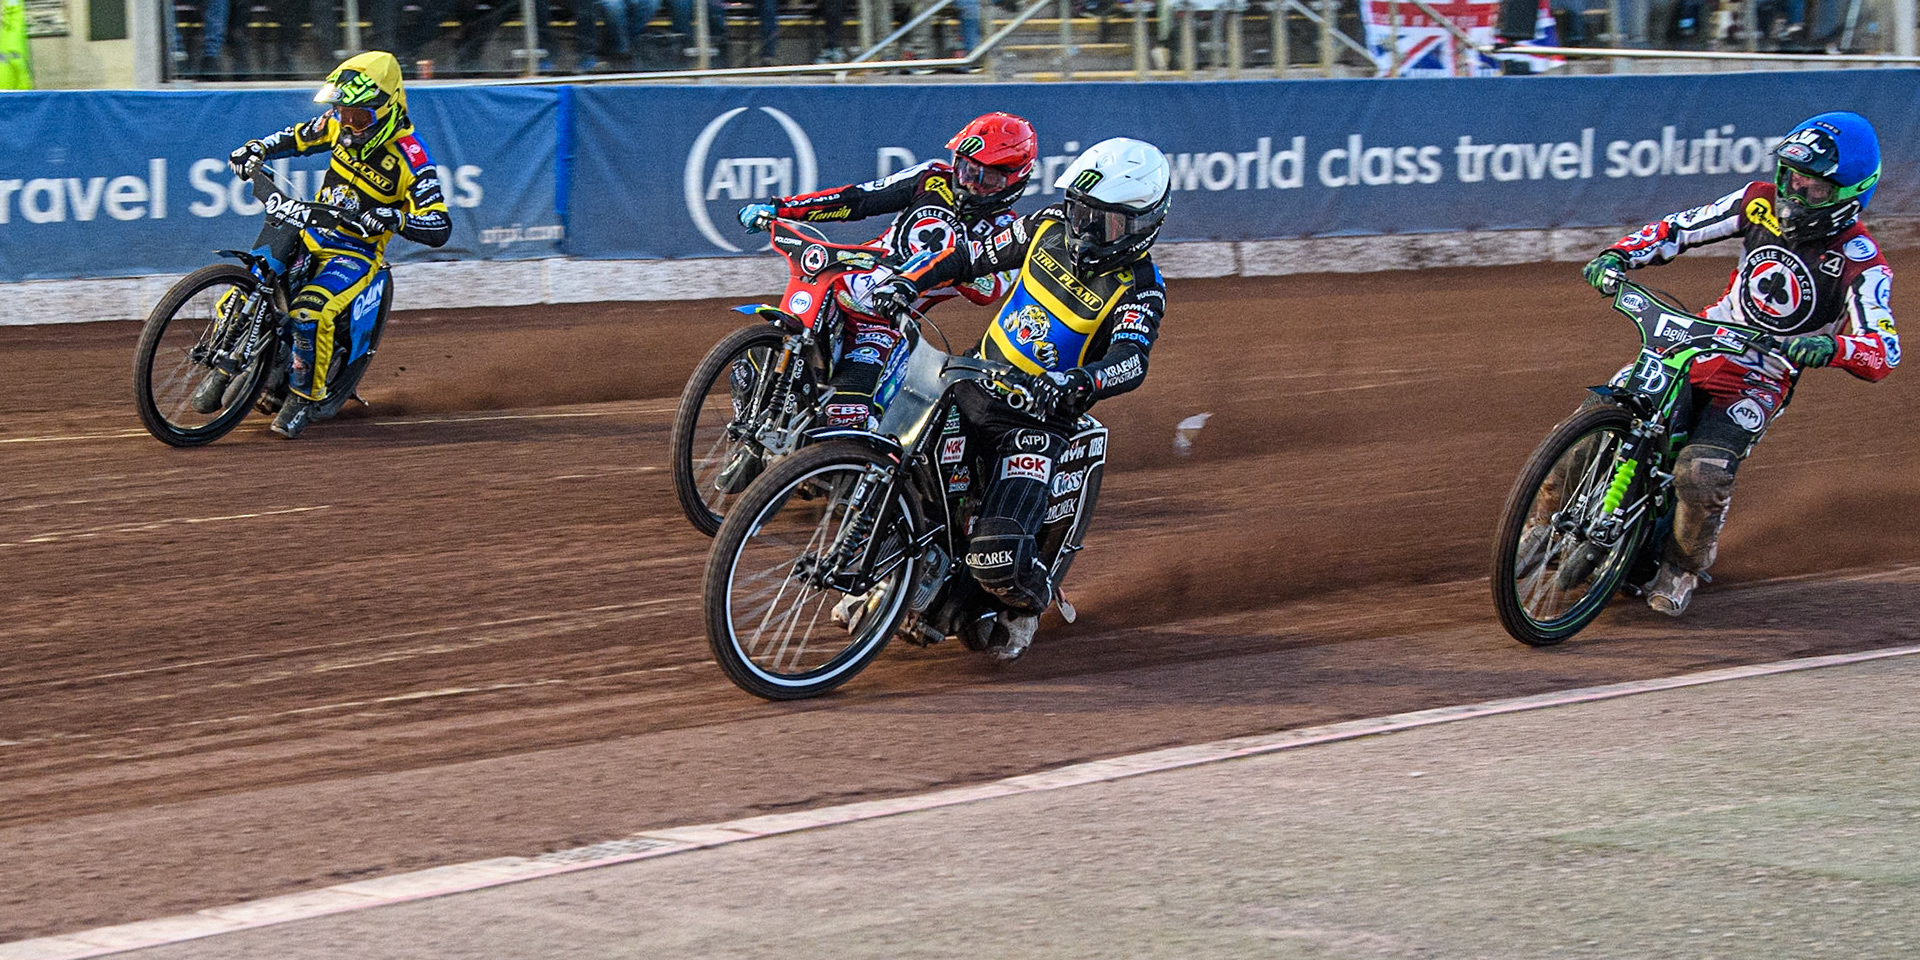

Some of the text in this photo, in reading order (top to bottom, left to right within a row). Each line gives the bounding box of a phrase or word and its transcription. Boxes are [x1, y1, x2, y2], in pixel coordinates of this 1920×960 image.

[381, 154, 397, 171] 6
[1318, 133, 1443, 188] class
[1454, 127, 1595, 183] travel
[706, 157, 793, 200] ATPI
[0, 157, 168, 224] ravel
[916, 208, 944, 220] BELLE
[1851, 238, 1870, 256] ATPI
[1824, 256, 1840, 273] 4
[1036, 252, 1059, 272] TRU
[1058, 273, 1101, 307] PLANT
[1749, 250, 1812, 302] BELLE VUE ACES
[1662, 325, 1693, 346] agilia
[1853, 350, 1885, 370] agilia
[827, 404, 868, 415] CBS
[1735, 406, 1759, 424] ATPI
[944, 440, 963, 456] NGK
[1021, 434, 1045, 446] ATPI
[1088, 436, 1105, 458] 108
[1007, 456, 1046, 474] NGK
